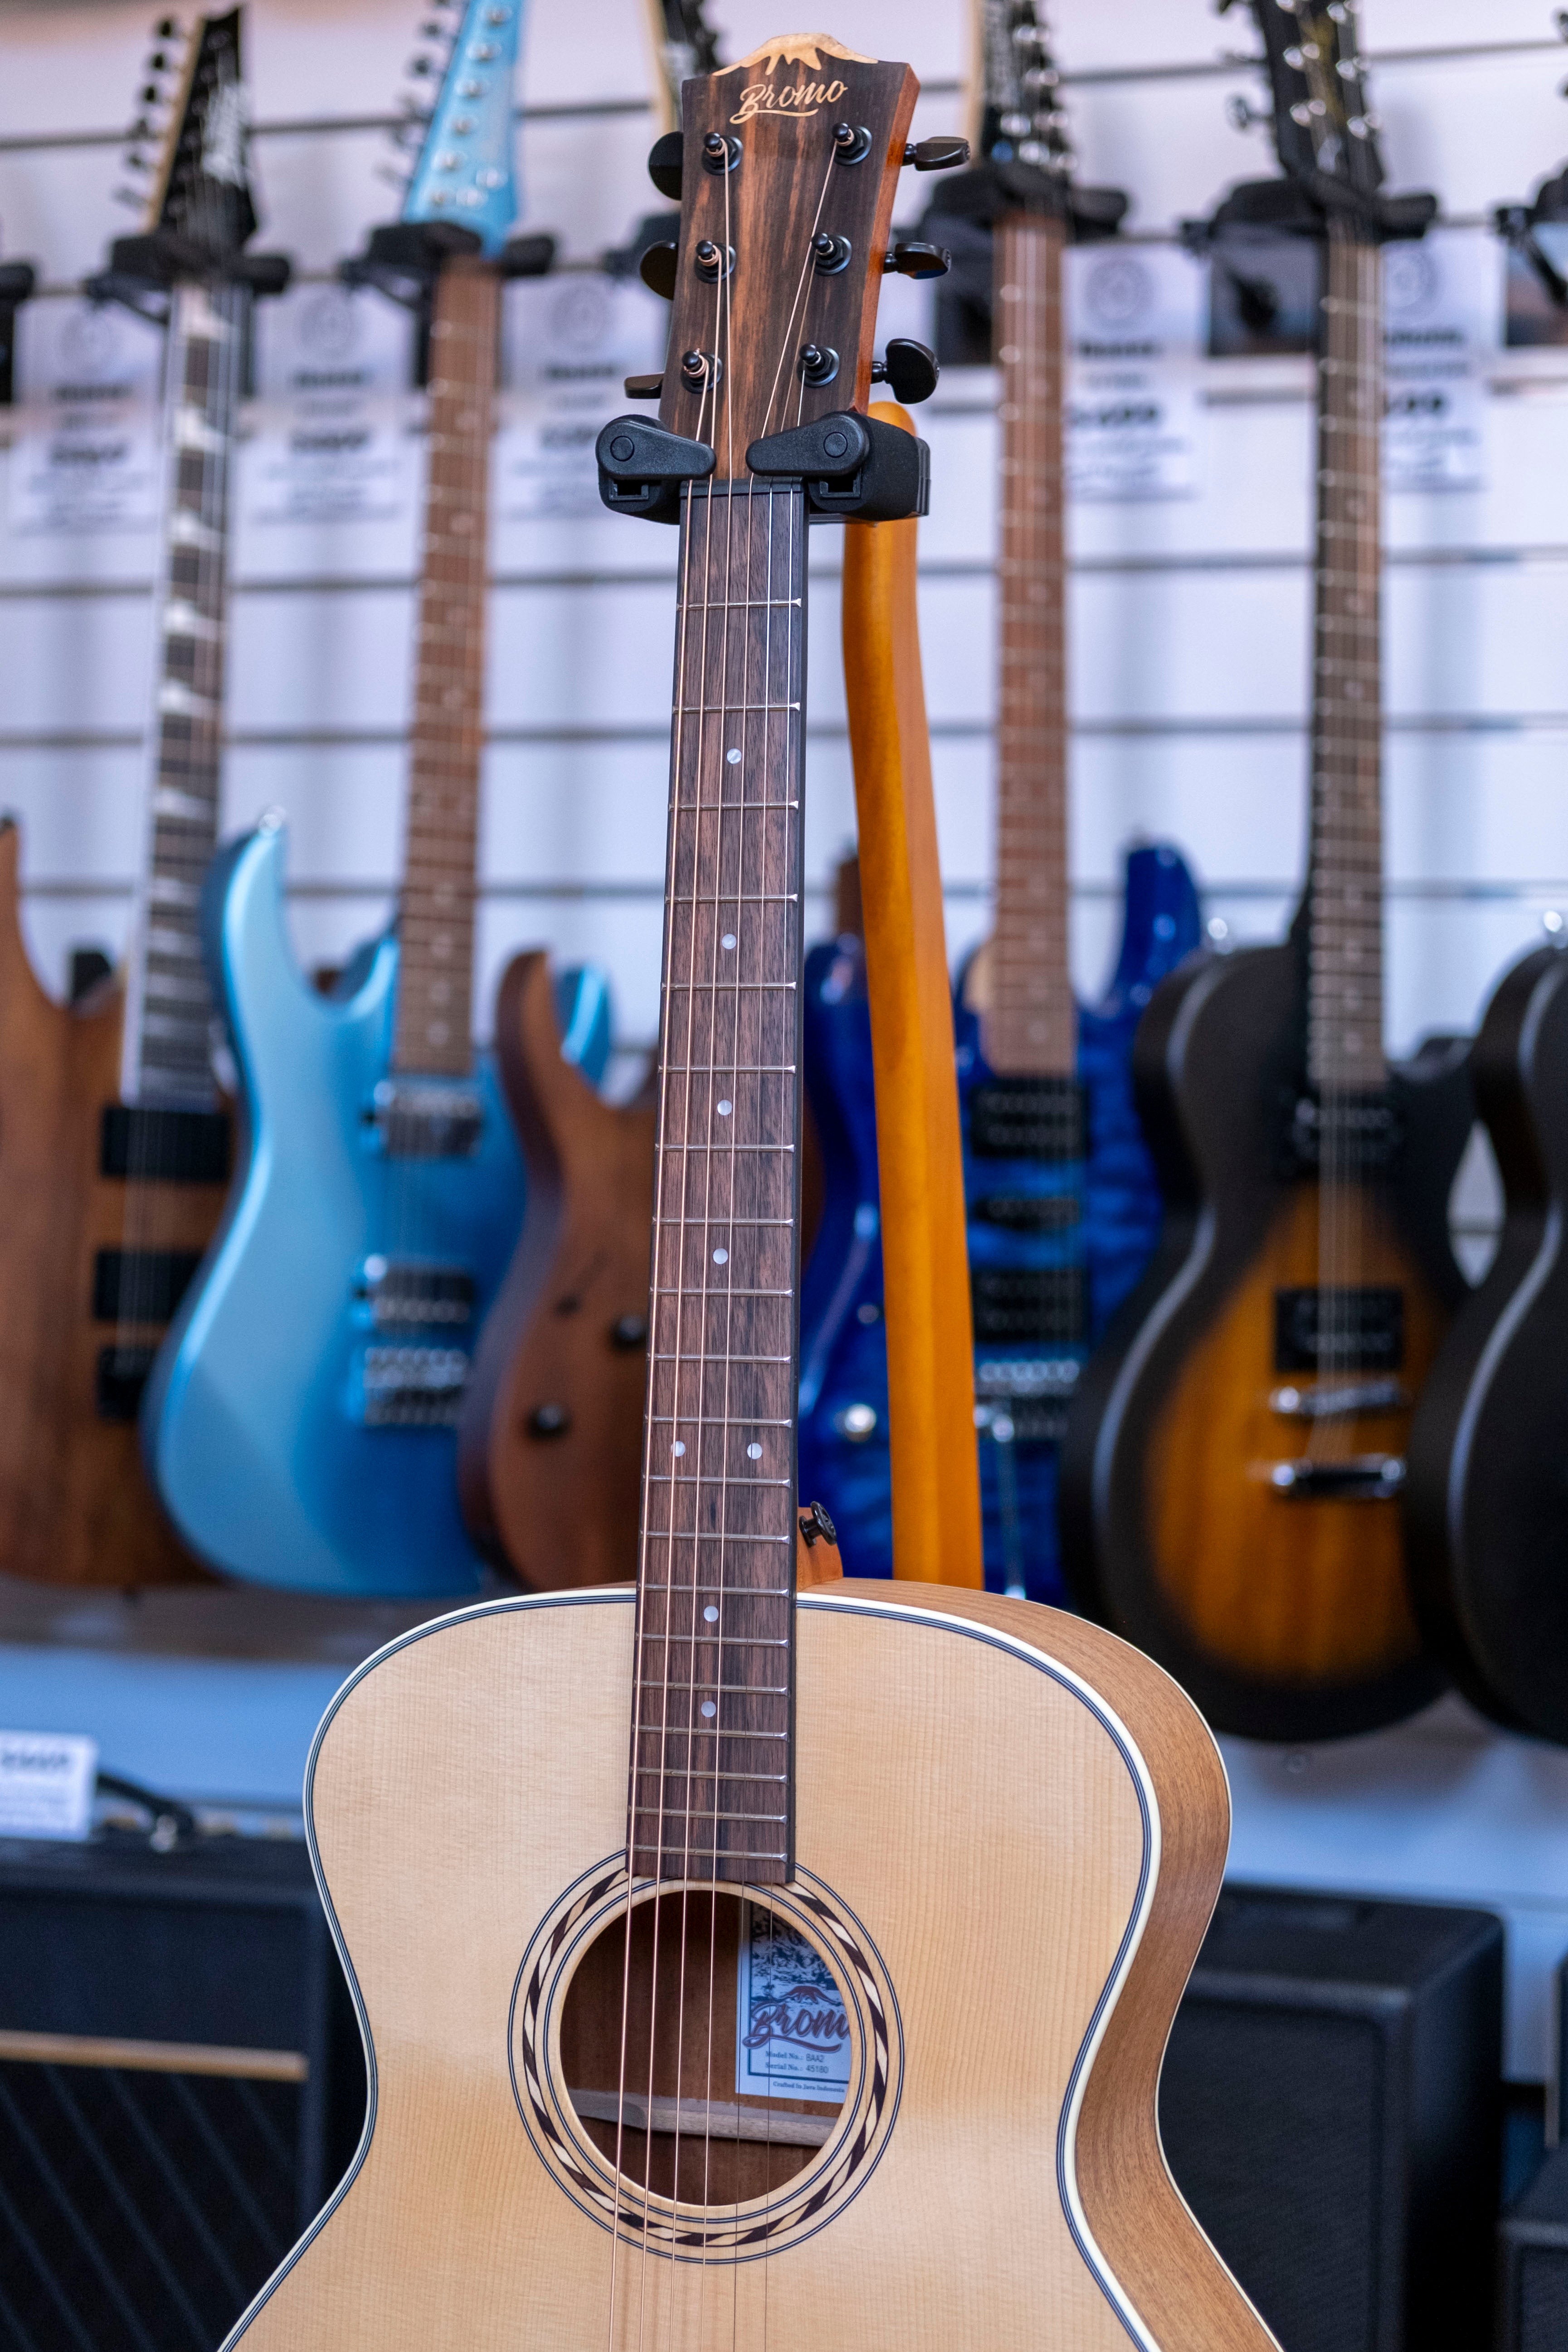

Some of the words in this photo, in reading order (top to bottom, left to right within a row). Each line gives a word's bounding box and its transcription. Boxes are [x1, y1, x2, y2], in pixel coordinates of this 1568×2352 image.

[730, 80, 848, 124] Bromo
[742, 2000, 850, 2054] Brom
[765, 2062, 787, 2070] Serial
